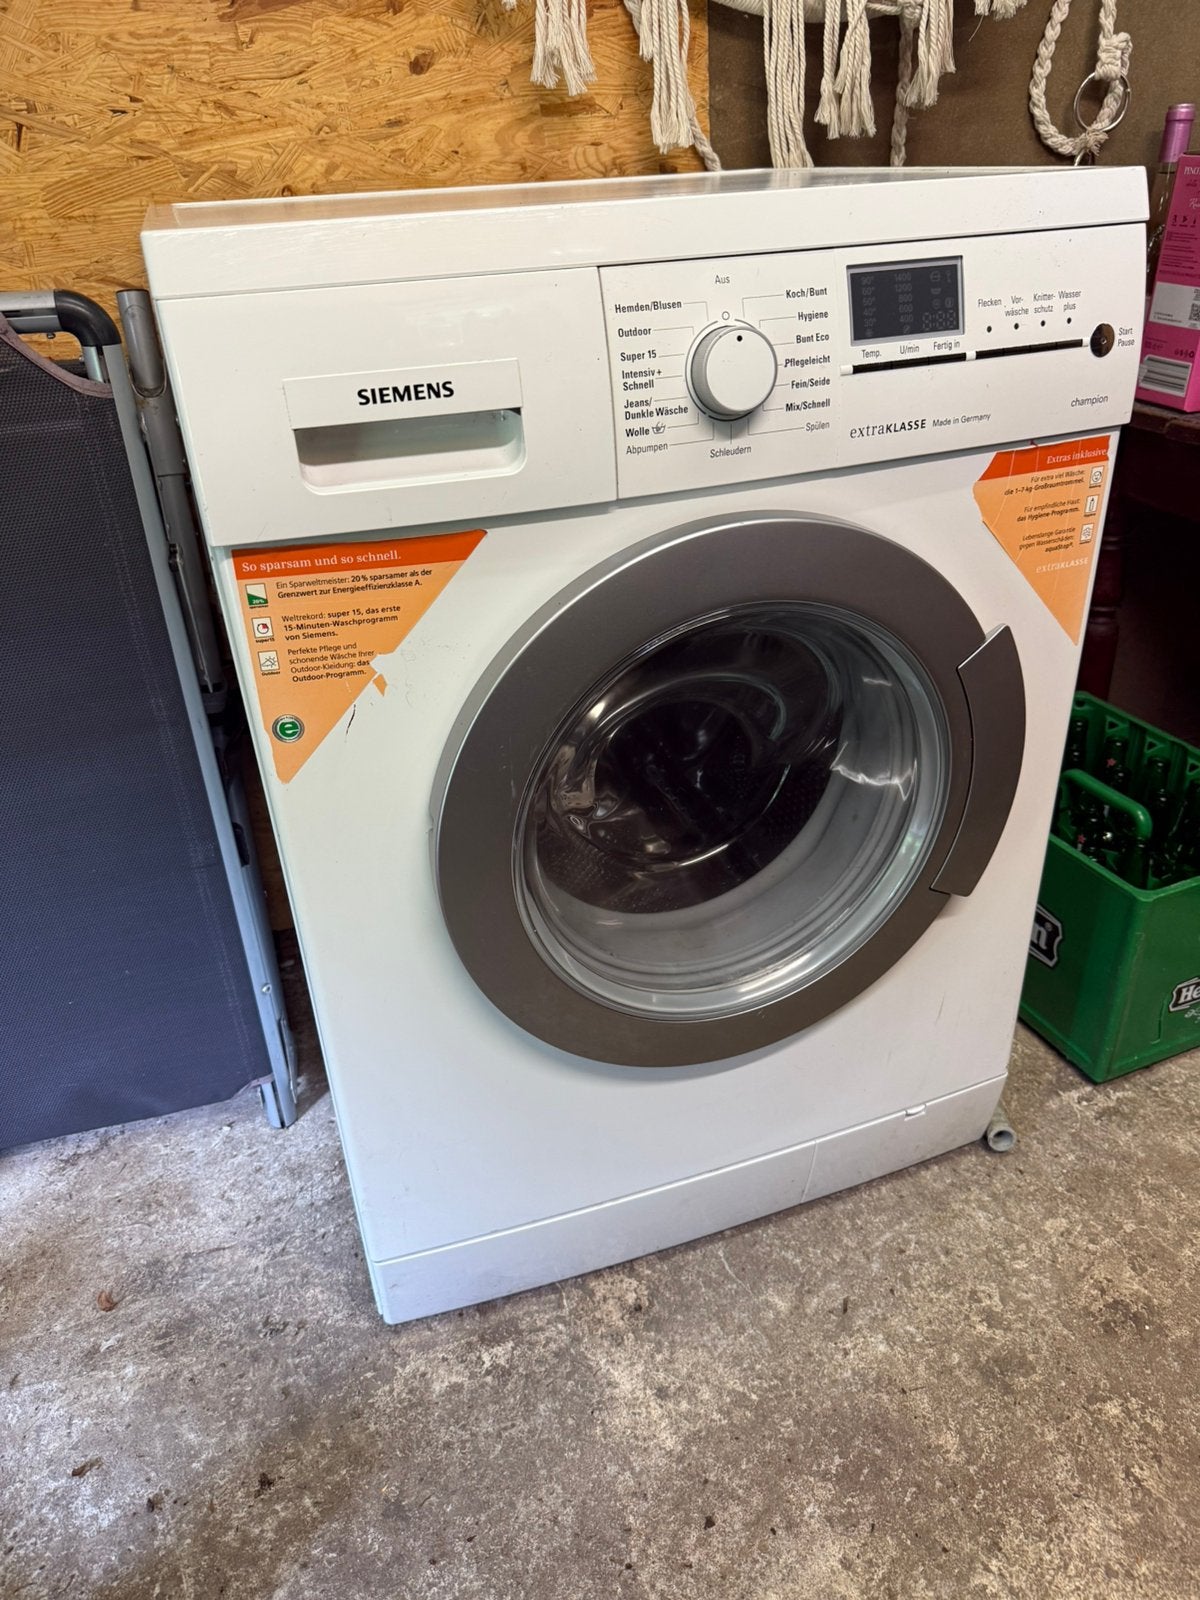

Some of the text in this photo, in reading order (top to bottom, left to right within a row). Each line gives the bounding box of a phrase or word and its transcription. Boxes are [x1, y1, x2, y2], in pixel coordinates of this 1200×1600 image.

[1184, 167, 1200, 175] PINO
[715, 275, 730, 284] Aus
[785, 287, 828, 299] Koch/Bunt
[1033, 292, 1056, 303] Knitter-
[1058, 290, 1081, 300] Wasser
[977, 298, 1002, 308] Flecken
[1010, 295, 1024, 305] Vor-
[615, 300, 682, 314] Hemden/Blusen
[1005, 307, 1030, 317] wäsche
[1033, 304, 1054, 314] schutz
[1063, 302, 1076, 312] plus
[798, 310, 829, 322] Hygiene
[618, 327, 652, 338] Outdoor
[1118, 327, 1132, 336] Start
[796, 333, 830, 344] Bunt Eco
[1117, 338, 1135, 347] Pause
[899, 344, 920, 355] U/min
[933, 340, 960, 352] Fertig in
[620, 350, 657, 364] Super 15
[861, 349, 882, 359] Temp.
[784, 355, 831, 368] Pflegeleicht
[622, 380, 654, 391] Schnell
[791, 378, 831, 389] Fein/Seide
[357, 381, 454, 406] SIEMENS
[623, 398, 652, 409] Jeans/
[785, 399, 831, 412] Mix/Schnell
[1070, 394, 1108, 408] champion
[624, 406, 689, 420] Dunkle Wäsche
[932, 413, 991, 428] Made in Germany
[805, 421, 830, 432] Spülen
[850, 418, 927, 439] extraKLASSE
[625, 427, 650, 438] Wolle
[626, 442, 668, 455] Abpumpen
[709, 446, 752, 459] Schleudern
[1047, 454, 1071, 464] Extras
[242, 550, 401, 573] So sparsam und so schnell.
[276, 581, 288, 589] Ein
[289, 577, 349, 590] Sparweltmeister:
[369, 571, 408, 582] sparsamer
[277, 590, 318, 599] Grenzwert
[332, 580, 413, 595] Energieeffizienzklasse
[282, 613, 326, 622] Weltrekord:
[328, 611, 350, 619] super
[381, 605, 401, 613] erste
[284, 615, 399, 631] 15-Minuten-Waschprogramm
[302, 631, 339, 639] Siemens.
[289, 655, 328, 665] schonende
[330, 652, 357, 660] Wäsche
[291, 663, 356, 674] Outdoor-Kleidung:
[292, 670, 367, 683] Outdoor-Programm.
